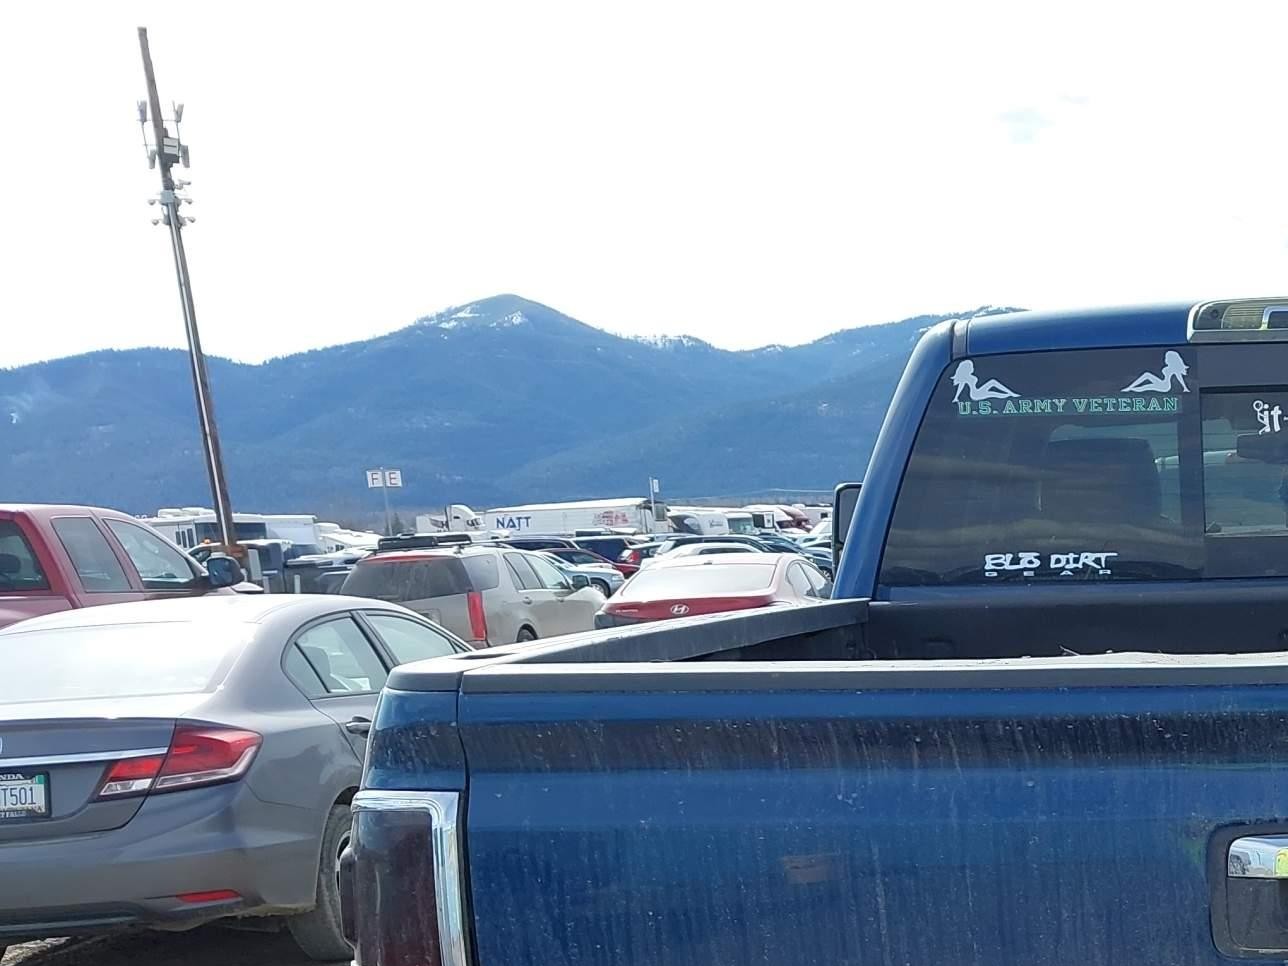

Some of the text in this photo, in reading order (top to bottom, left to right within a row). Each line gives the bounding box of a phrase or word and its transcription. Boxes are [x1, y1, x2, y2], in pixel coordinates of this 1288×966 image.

[958, 397, 1178, 415] U.S. ARMY VETERAN
[371, 472, 380, 486] F
[388, 471, 399, 486] E
[496, 516, 531, 531] NATT
[1050, 552, 1118, 569] DIRT
